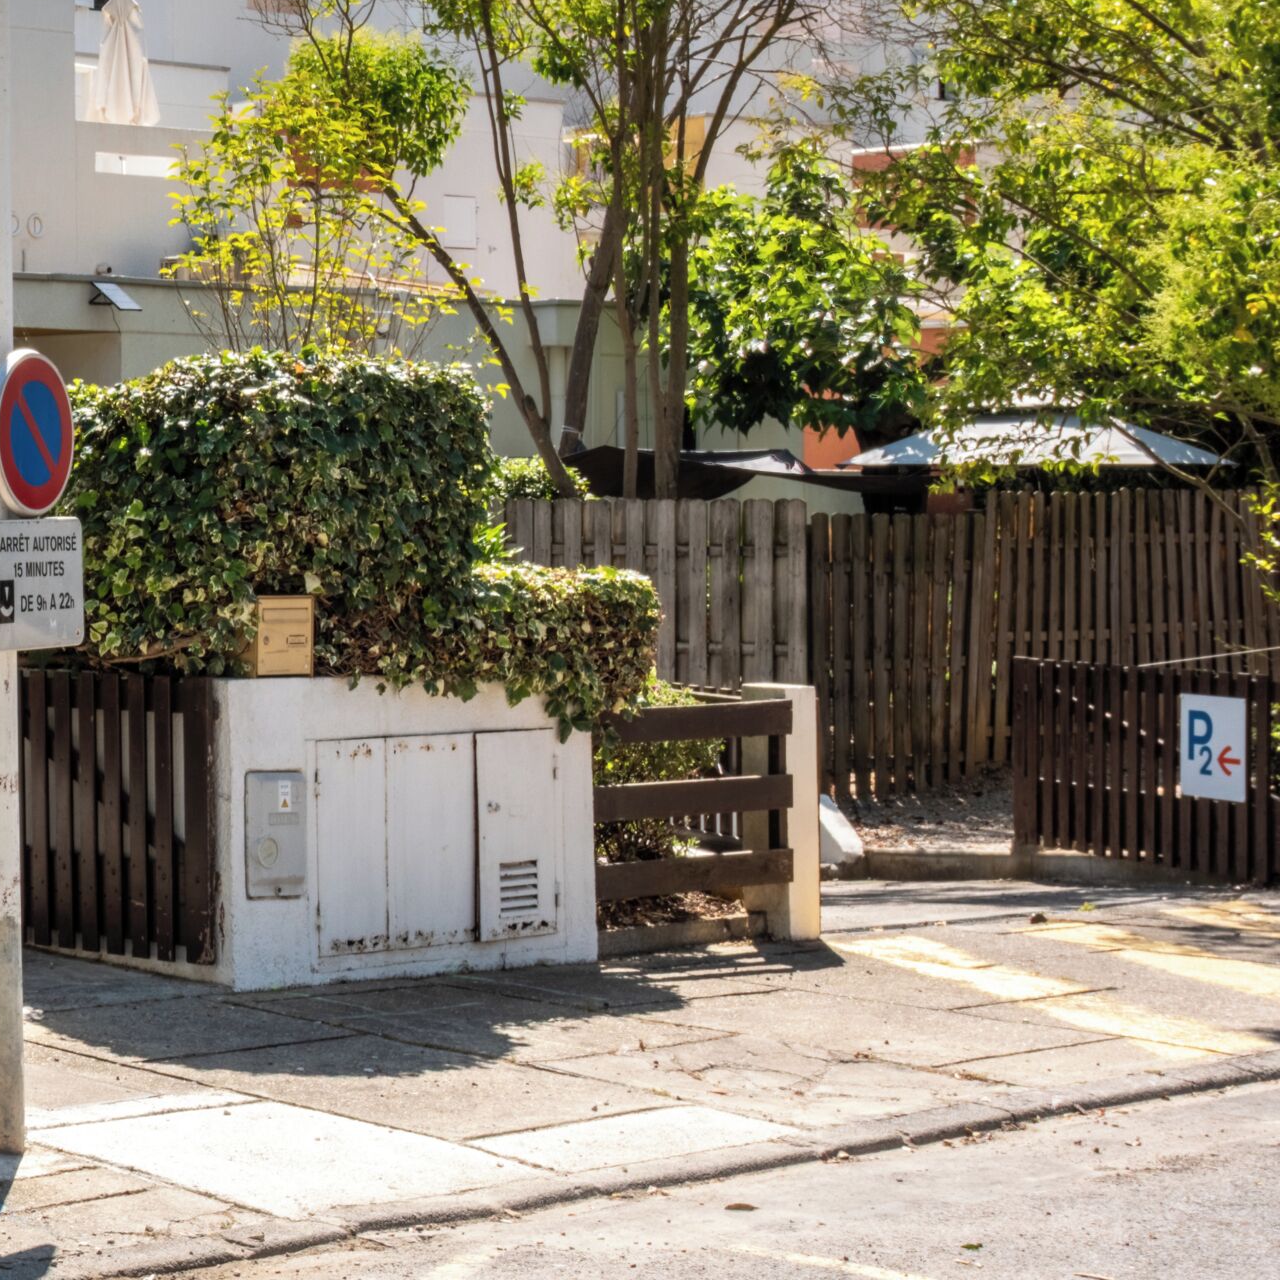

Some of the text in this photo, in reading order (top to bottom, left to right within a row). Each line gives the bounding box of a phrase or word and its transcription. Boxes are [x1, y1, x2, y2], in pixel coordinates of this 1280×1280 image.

[0, 533, 77, 552] ARRÊT AUTORISÉ
[13, 561, 65, 578] 15 MINUTES
[20, 592, 75, 612] DE 9h A 22h
